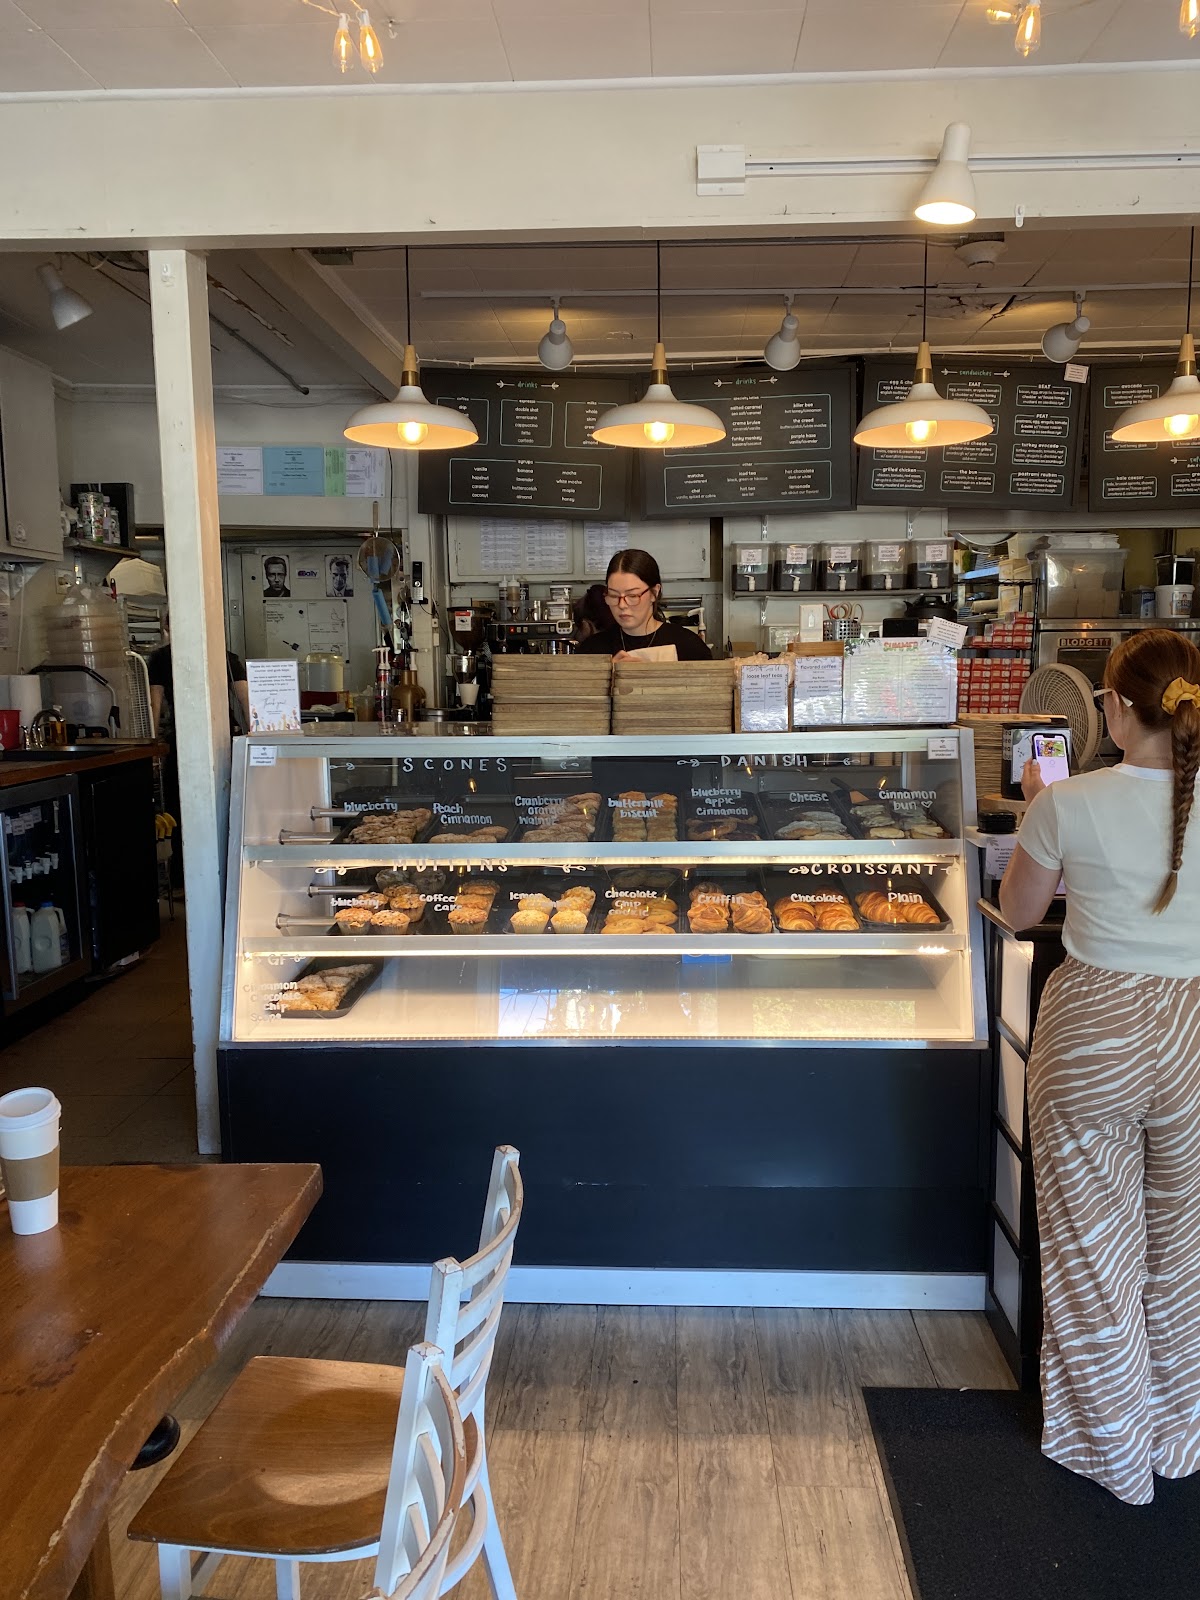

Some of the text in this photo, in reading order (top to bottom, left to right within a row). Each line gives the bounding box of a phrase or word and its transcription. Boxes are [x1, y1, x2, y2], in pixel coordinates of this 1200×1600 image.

[403, 758, 507, 772] SCONES
[721, 755, 808, 768] DANISH
[692, 788, 742, 798] blueberry
[789, 792, 829, 803] Cheese
[879, 789, 937, 800] Cinnamon
[344, 802, 398, 812] blueberry
[515, 796, 566, 807] Cranberry
[608, 798, 664, 808] buttermilk
[705, 797, 735, 806] apple
[893, 799, 917, 811] bun
[433, 802, 464, 815] Peach
[620, 809, 659, 819] biscuit
[696, 807, 748, 816] Cinnamon
[441, 814, 492, 825] Cinnamon
[812, 864, 938, 875] CROISSANT
[330, 898, 379, 909] blueberry
[419, 894, 456, 902] Coffee
[698, 894, 745, 906] Cruffin
[888, 892, 923, 904] Plain
